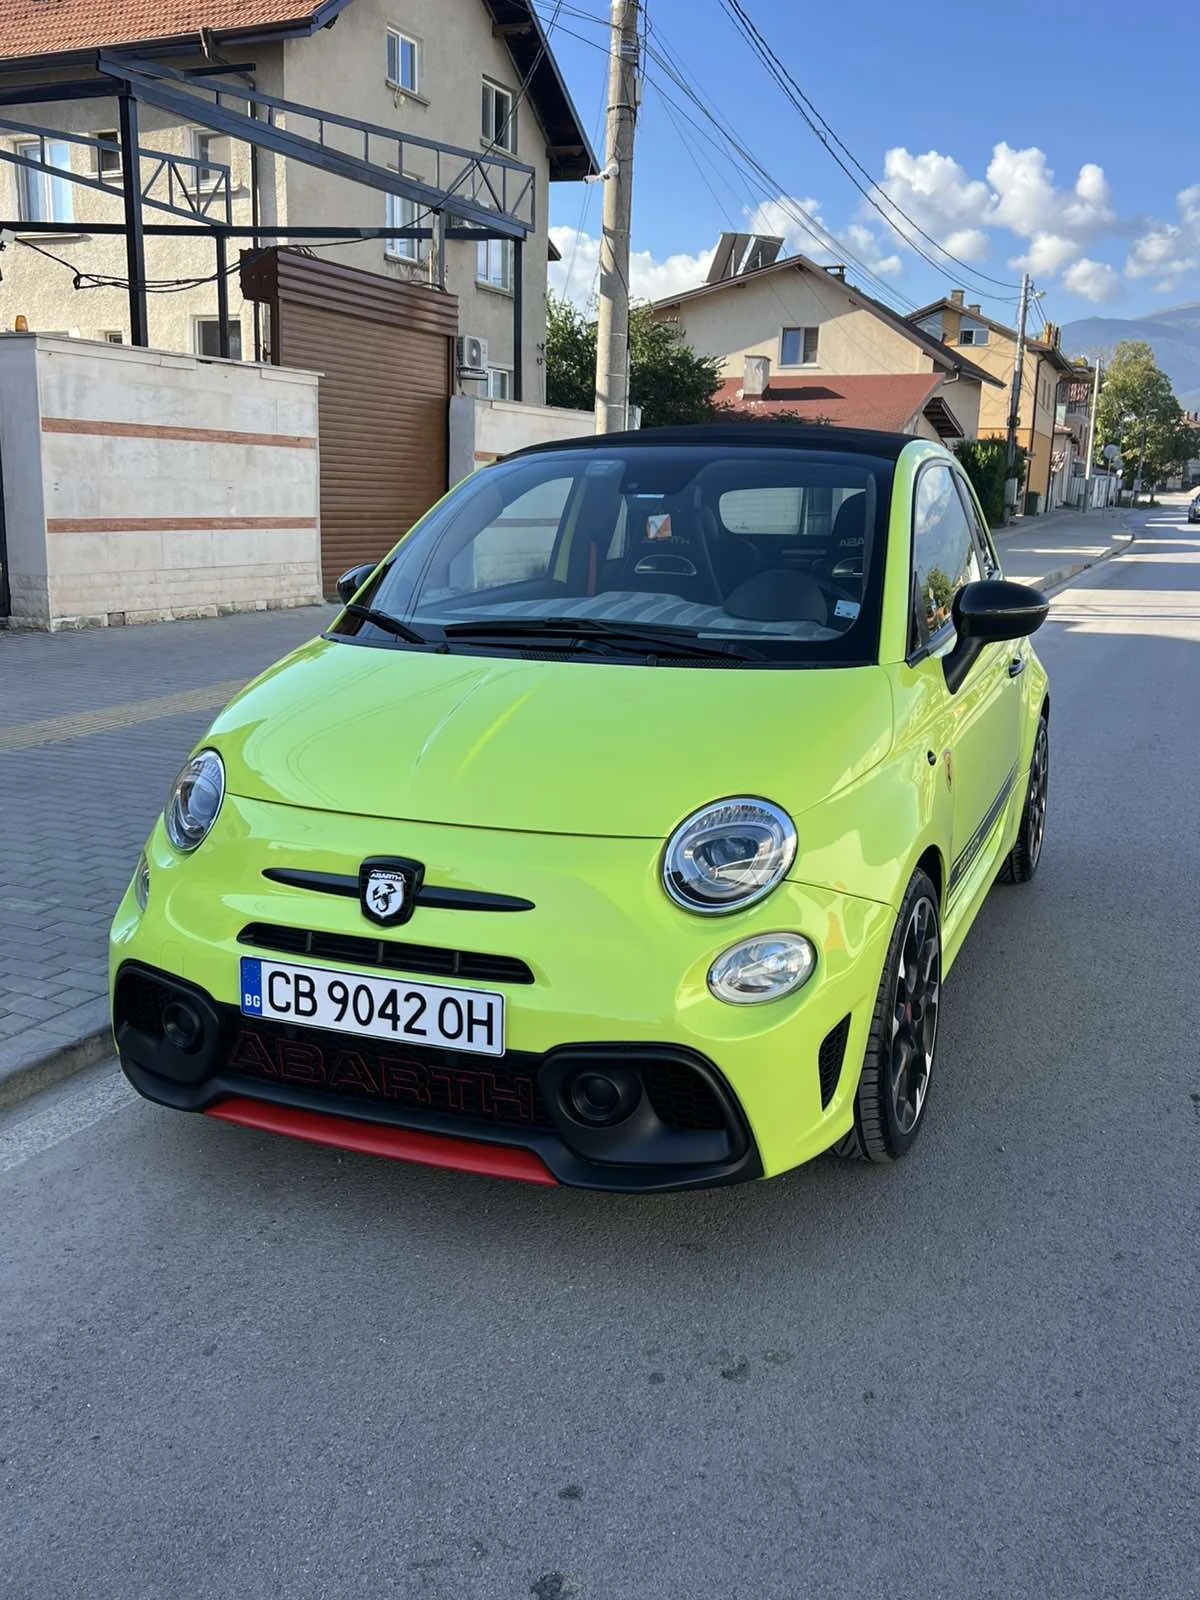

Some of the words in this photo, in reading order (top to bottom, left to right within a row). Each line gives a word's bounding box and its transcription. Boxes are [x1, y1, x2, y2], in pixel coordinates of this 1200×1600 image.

[370, 871, 402, 881] ABARTH
[245, 994, 261, 1008] BG
[268, 970, 318, 1018] CB
[327, 980, 427, 1036] 9042
[438, 996, 494, 1046] OH
[228, 1030, 535, 1122] ABARTH
